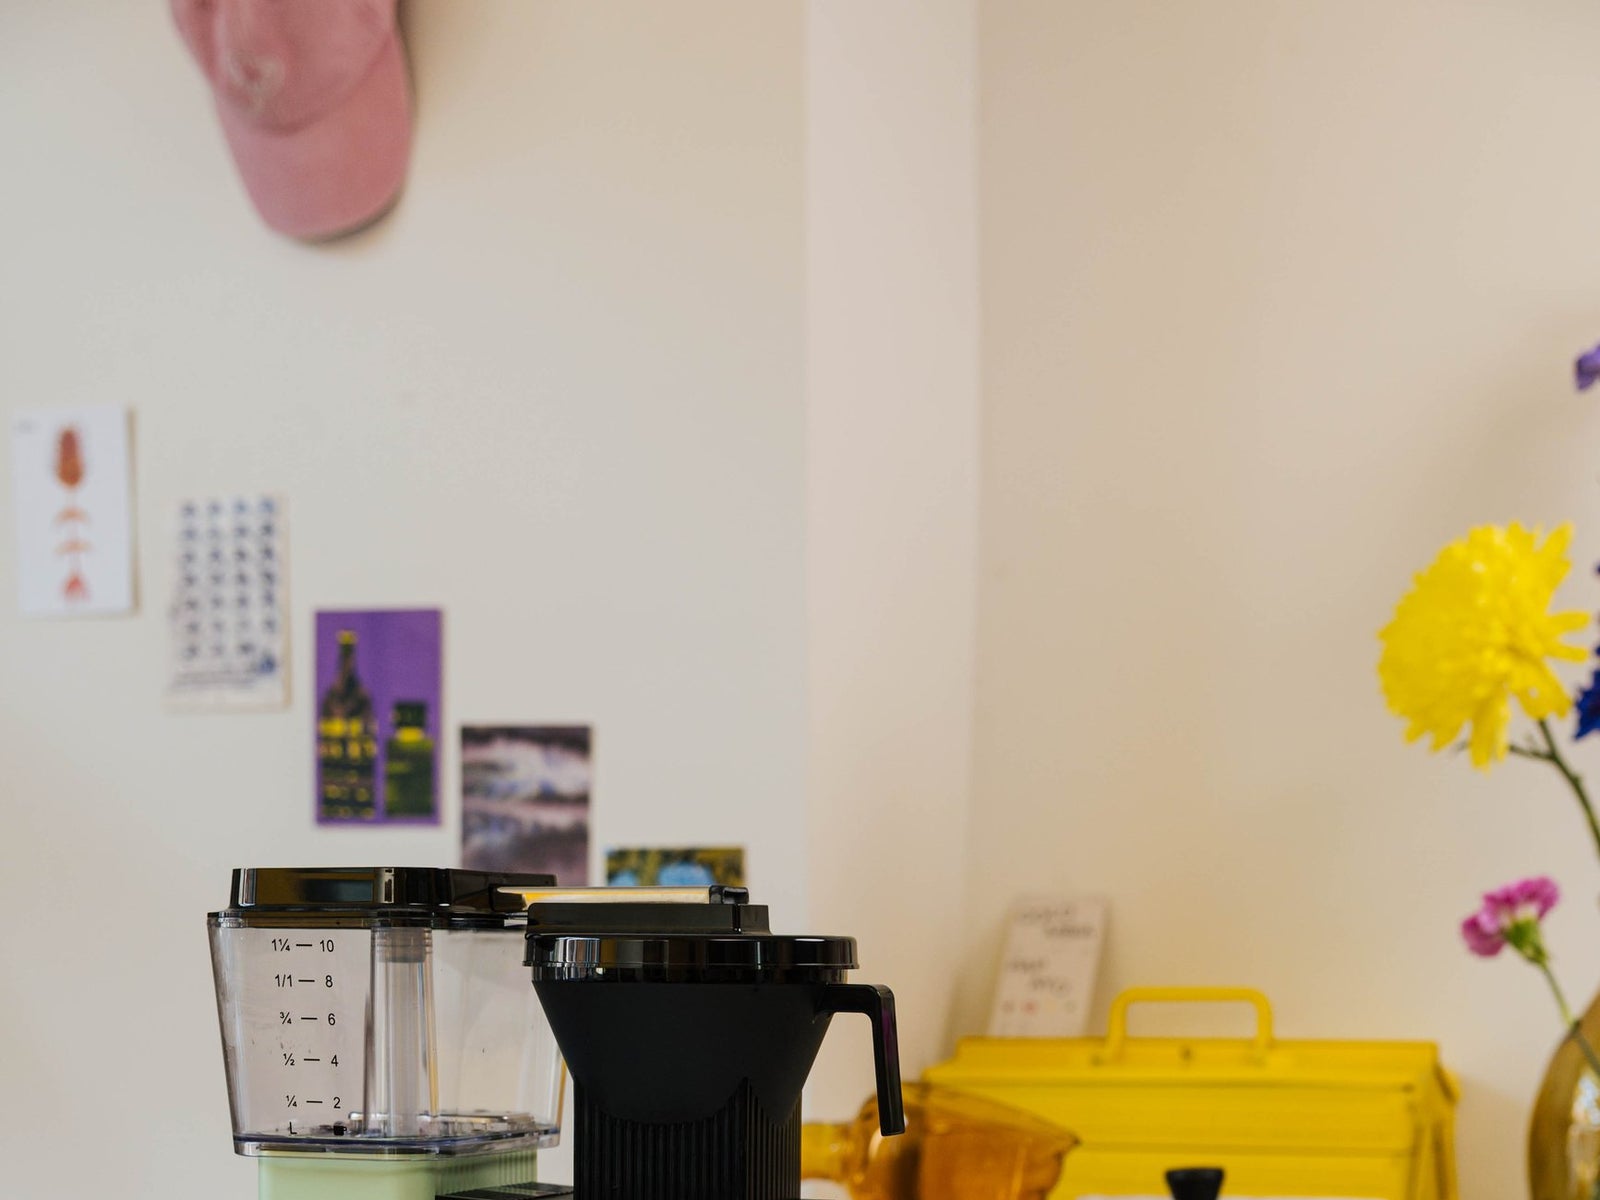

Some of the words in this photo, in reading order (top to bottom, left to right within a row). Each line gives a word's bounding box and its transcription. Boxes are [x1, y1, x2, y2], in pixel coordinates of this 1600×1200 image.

[319, 939, 335, 952] 10
[274, 973, 293, 988] 1/1
[325, 974, 333, 988] 8
[327, 1013, 336, 1026] 6
[330, 1054, 339, 1067] 4
[333, 1096, 341, 1109] 2
[289, 1121, 297, 1135] L
